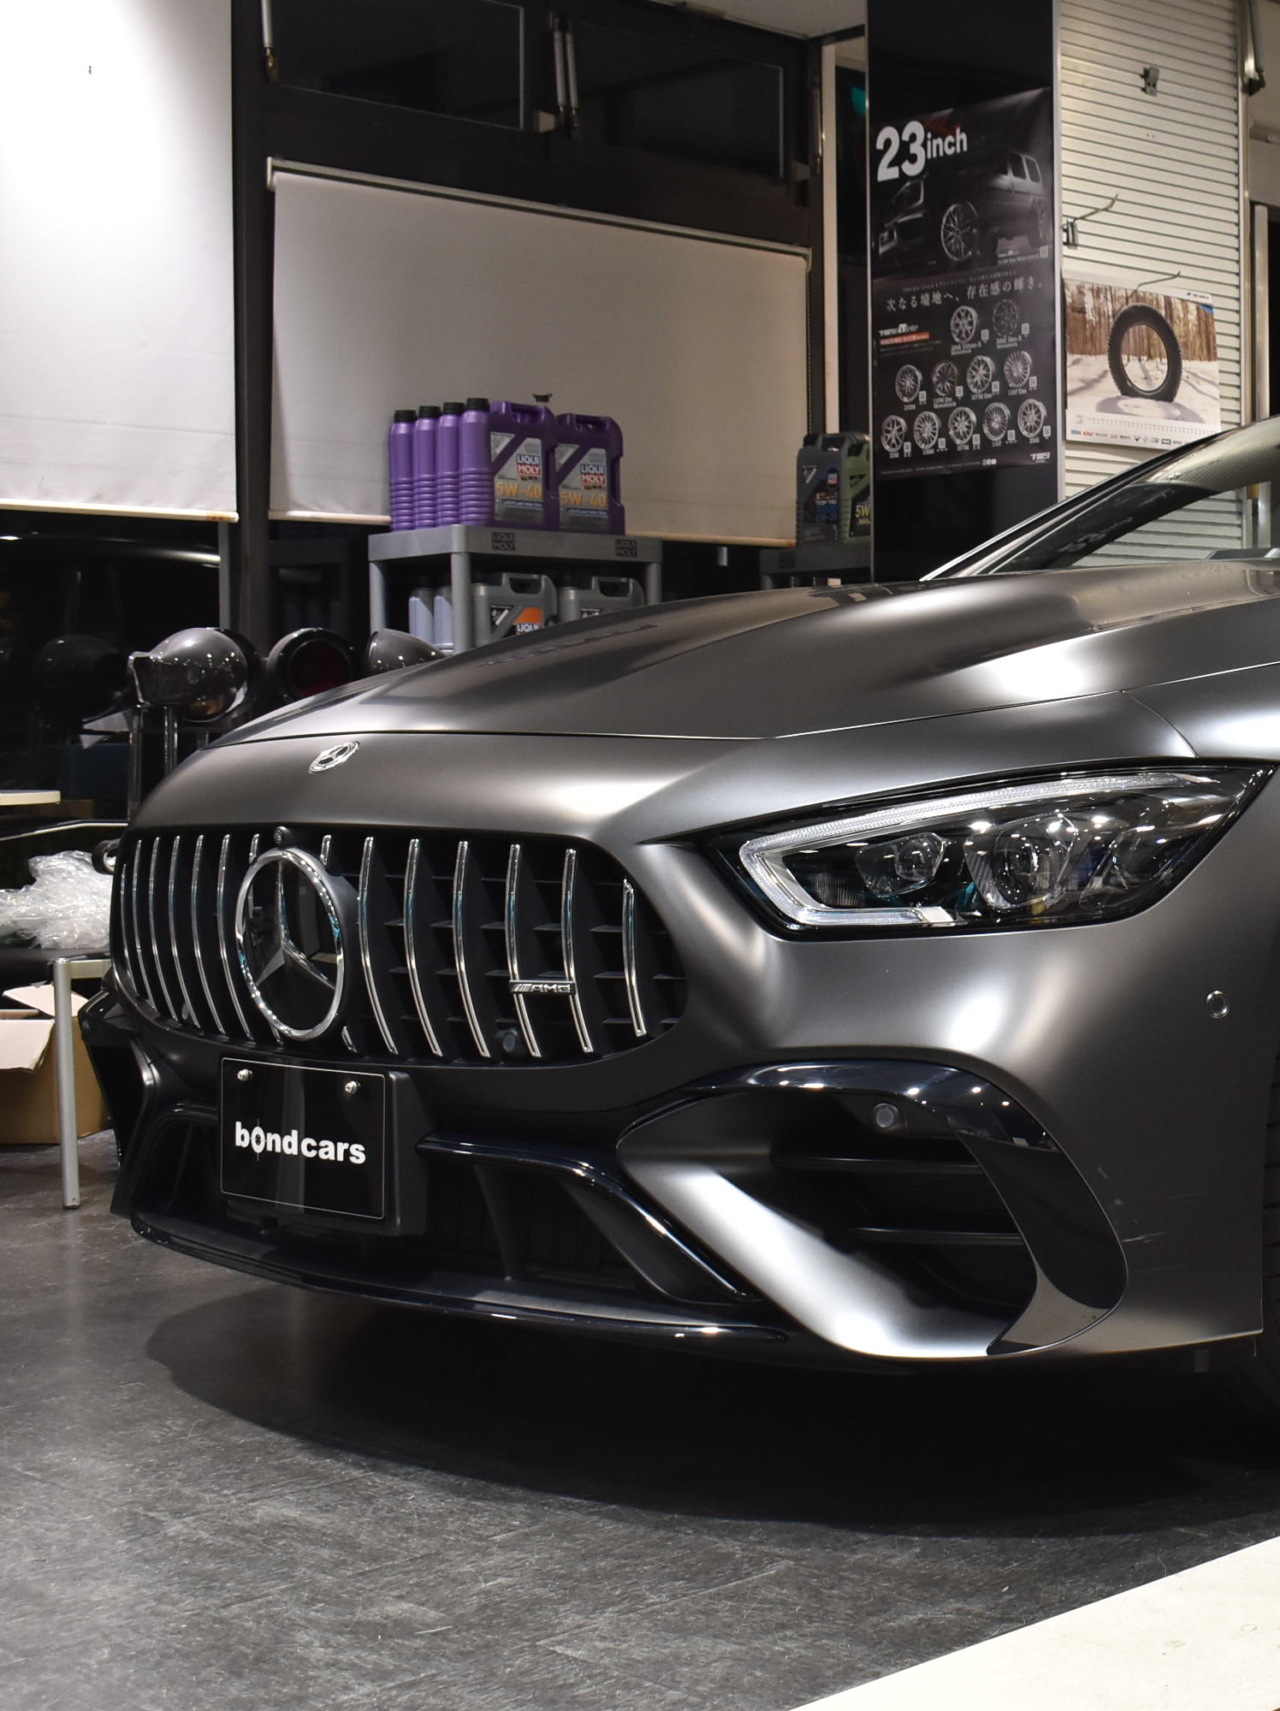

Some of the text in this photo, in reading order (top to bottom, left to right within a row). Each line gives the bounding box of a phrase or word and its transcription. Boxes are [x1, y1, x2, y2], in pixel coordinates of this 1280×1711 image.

[517, 455, 540, 464] LIQUI
[518, 465, 541, 475] MOLY
[582, 465, 604, 474] LIQUI
[582, 475, 605, 484] MOLY
[496, 482, 542, 499] 5W-40
[561, 491, 607, 508] 5W-40
